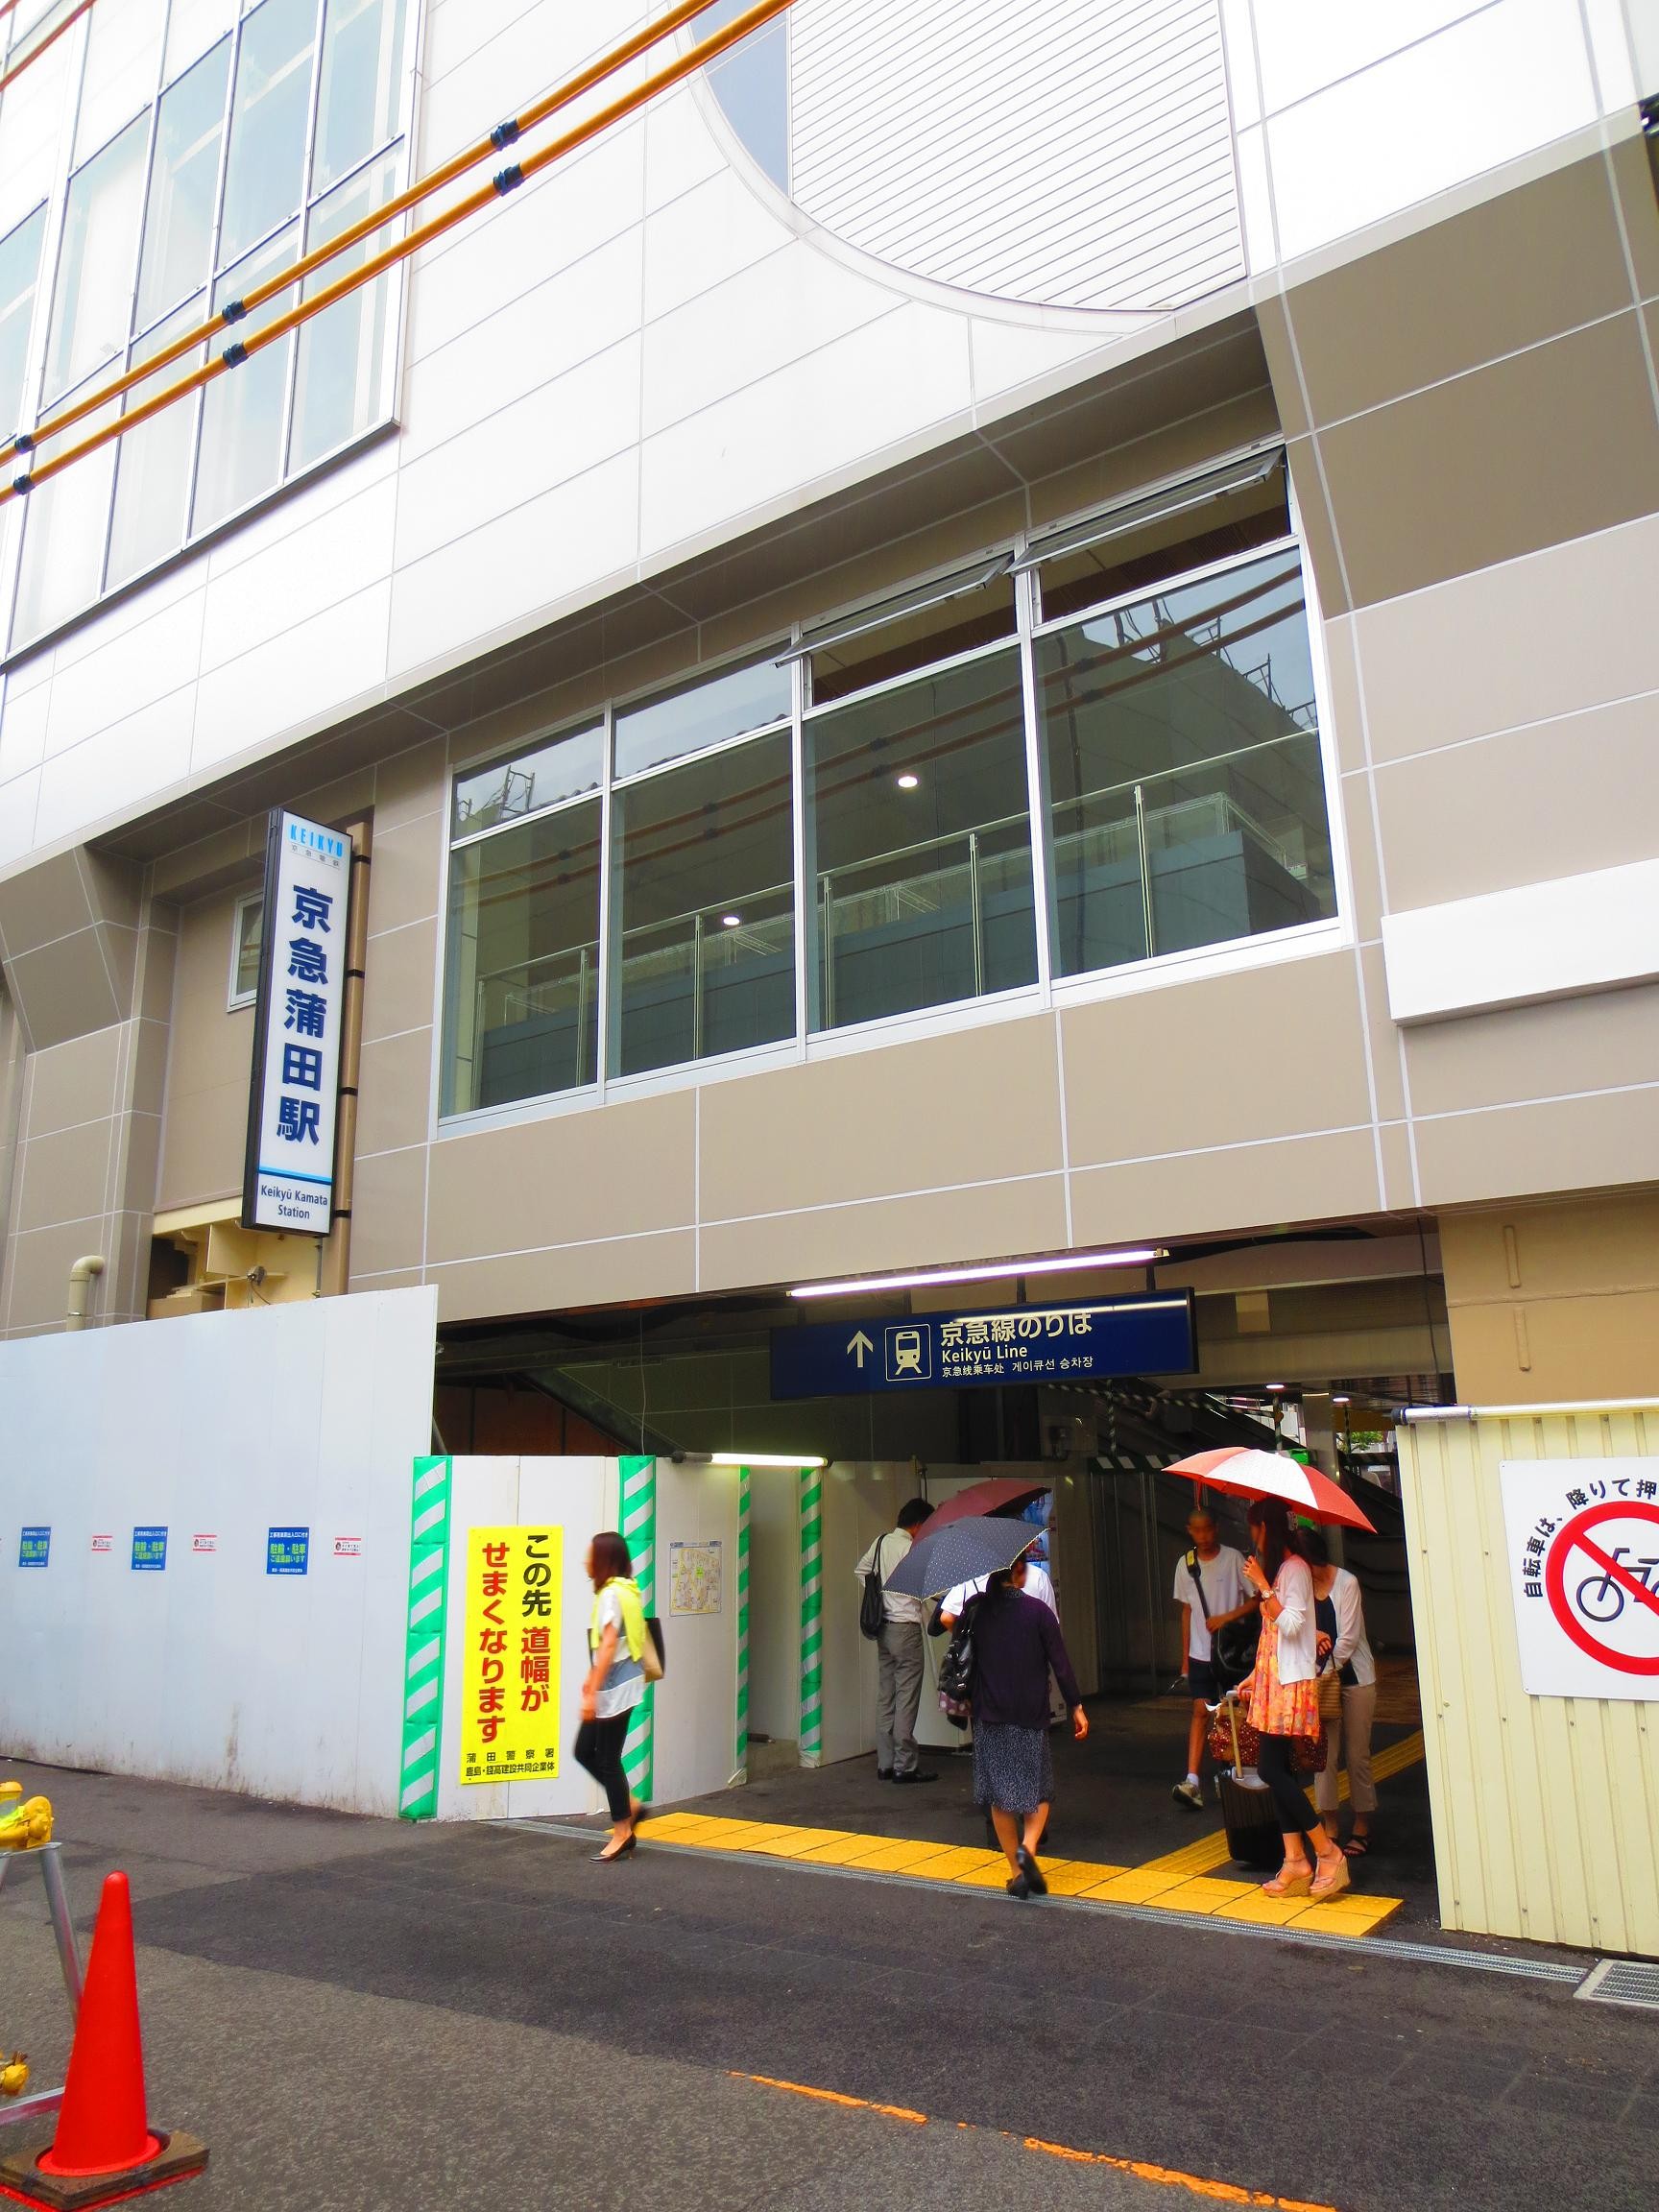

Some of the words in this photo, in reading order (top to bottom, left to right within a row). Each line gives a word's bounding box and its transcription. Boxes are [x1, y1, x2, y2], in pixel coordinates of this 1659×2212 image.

[290, 824, 343, 857] KEIKYU
[276, 883, 333, 1146] 京急蒲田駅
[261, 1184, 292, 1201] Keikyū
[295, 1190, 328, 1206] Kamata
[277, 1204, 310, 1219] Station
[942, 1347, 991, 1363] Keikyū
[997, 1344, 1027, 1358] Line
[1012, 1358, 1055, 1372] 게이큐선
[1059, 1356, 1094, 1369] 승차장
[942, 1362, 1004, 1378] 京急线乘车处
[521, 1534, 552, 1618] この先
[476, 1542, 511, 1743] せまくなります
[520, 1626, 551, 1712] 道幅が
